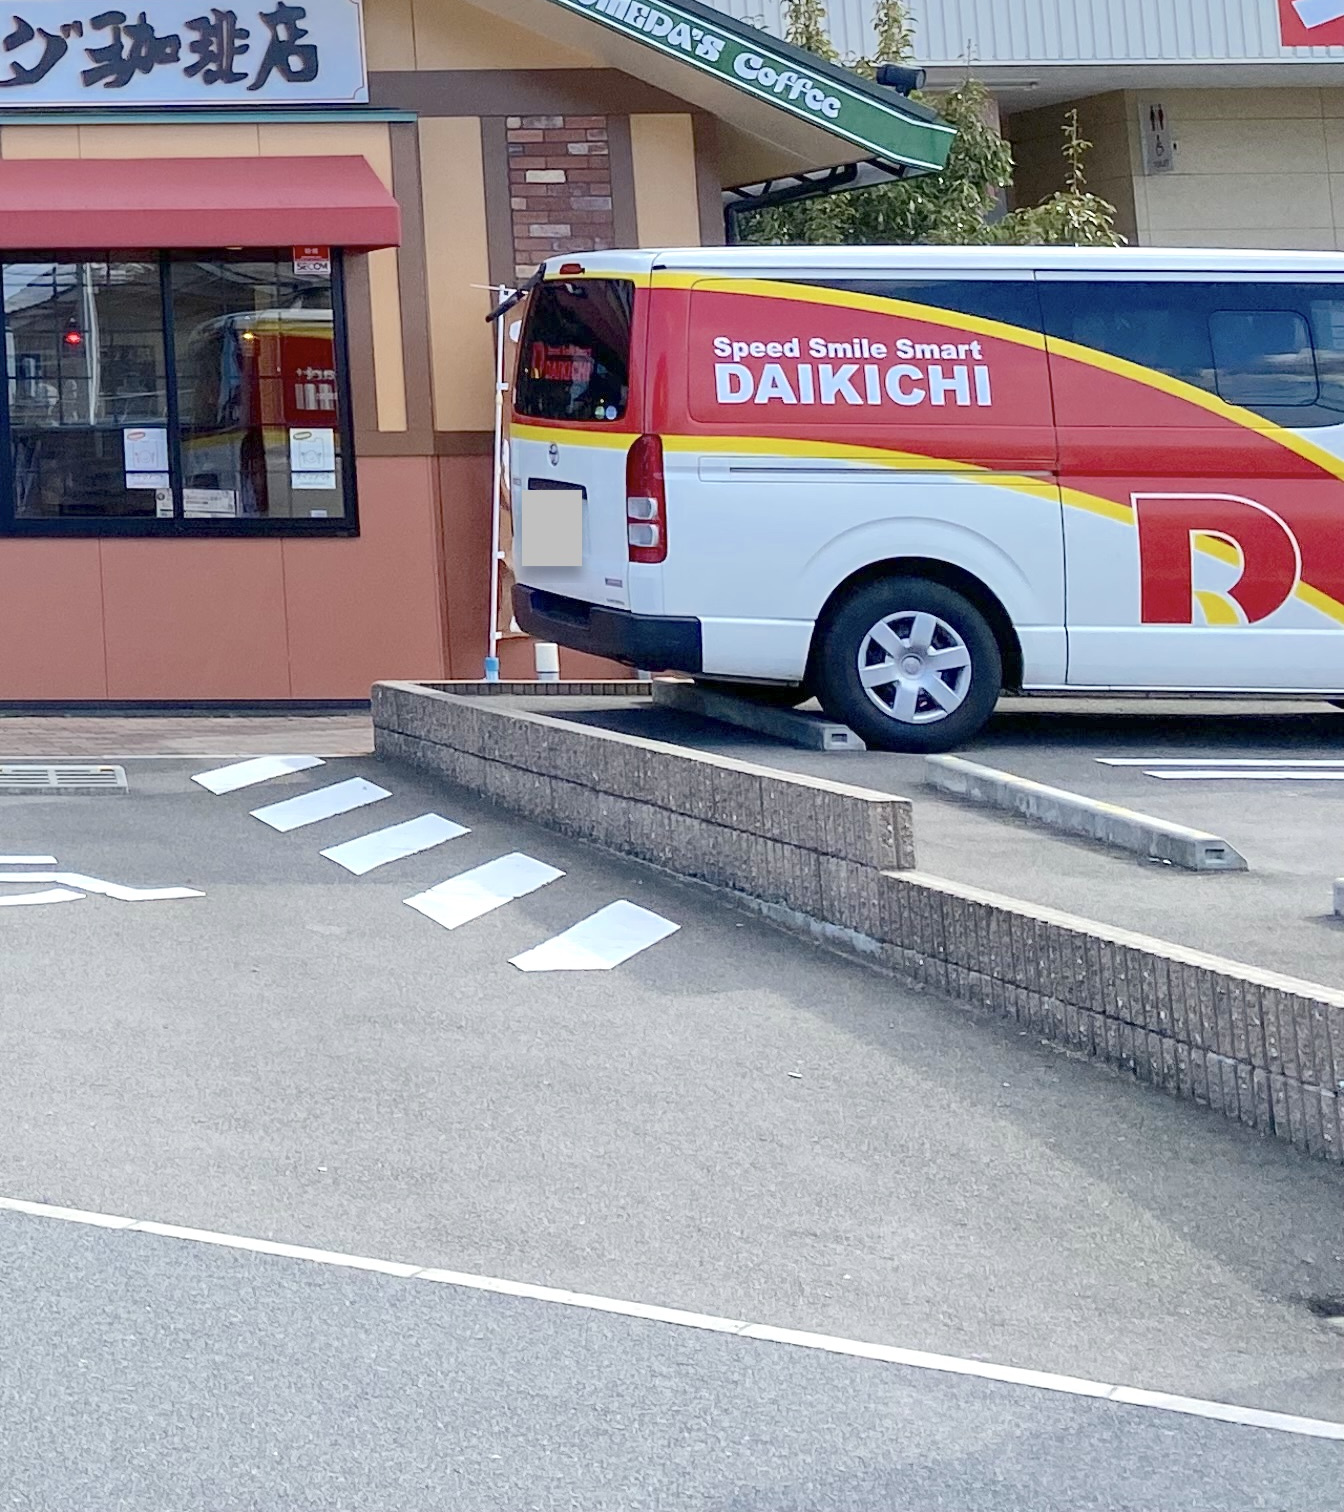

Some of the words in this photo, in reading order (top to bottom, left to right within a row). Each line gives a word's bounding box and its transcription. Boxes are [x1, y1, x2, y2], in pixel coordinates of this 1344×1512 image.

[733, 52, 842, 119] Coffee
[713, 337, 801, 363] Speed
[808, 337, 889, 359] Smile
[895, 339, 982, 360] Smart
[714, 362, 993, 407] DAIKICHI
